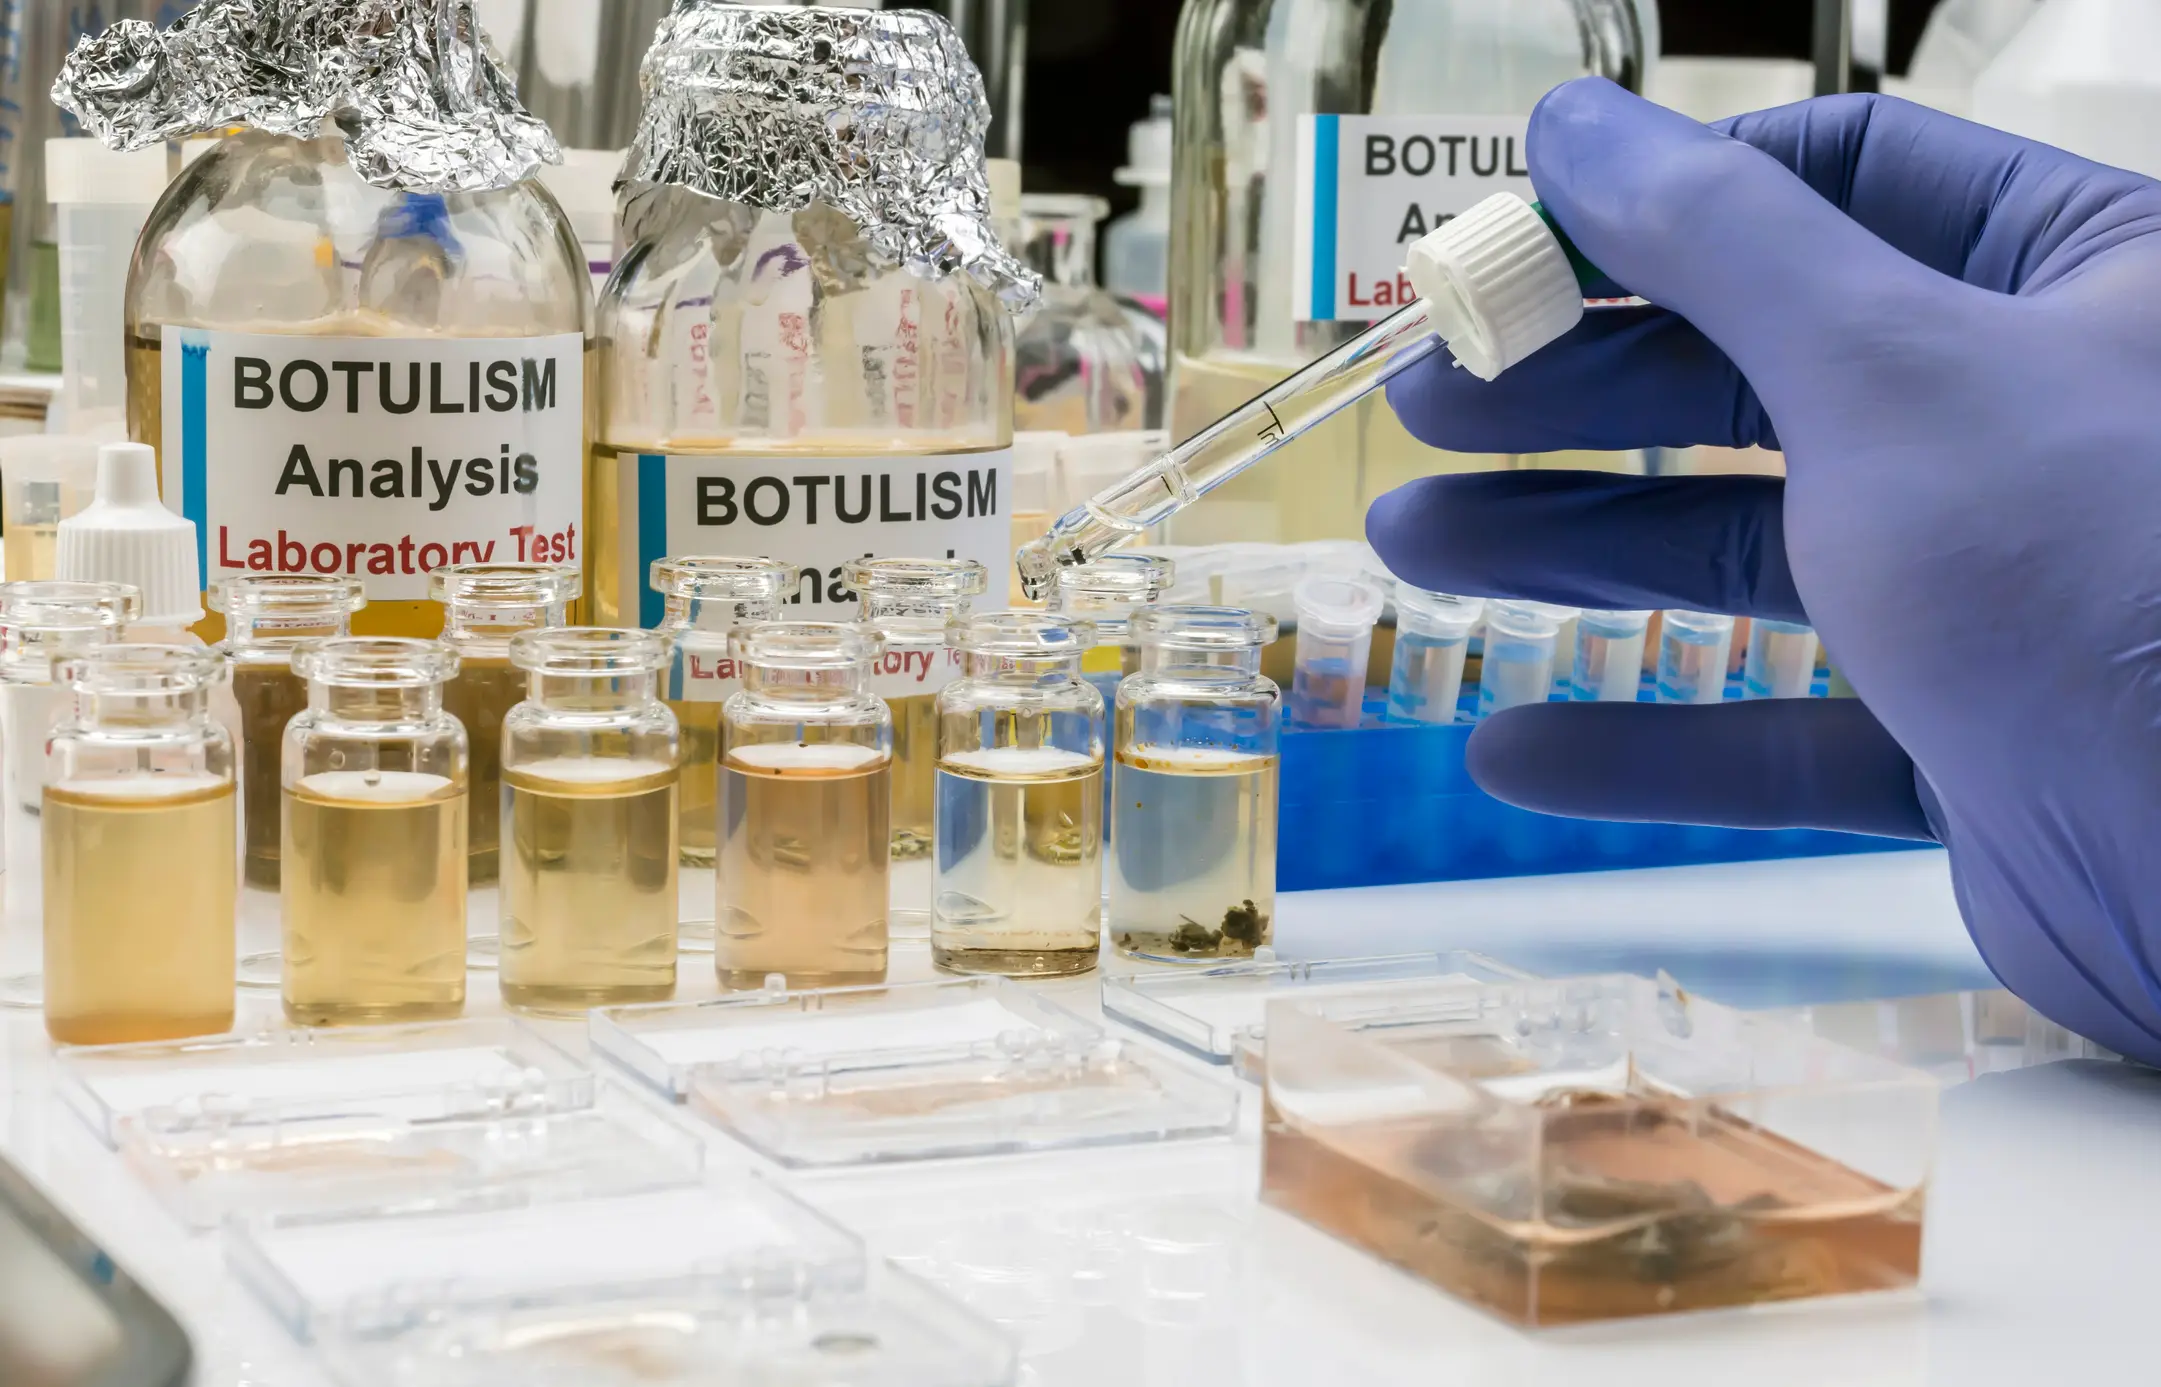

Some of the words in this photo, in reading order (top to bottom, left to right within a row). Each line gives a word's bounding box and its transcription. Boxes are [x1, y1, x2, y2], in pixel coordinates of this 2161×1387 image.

[1365, 135, 1528, 177] BOTUL
[234, 356, 556, 414] BOTULISM
[275, 444, 539, 511] Analysis
[696, 468, 997, 526] BOTULISM
[509, 522, 575, 562] Test
